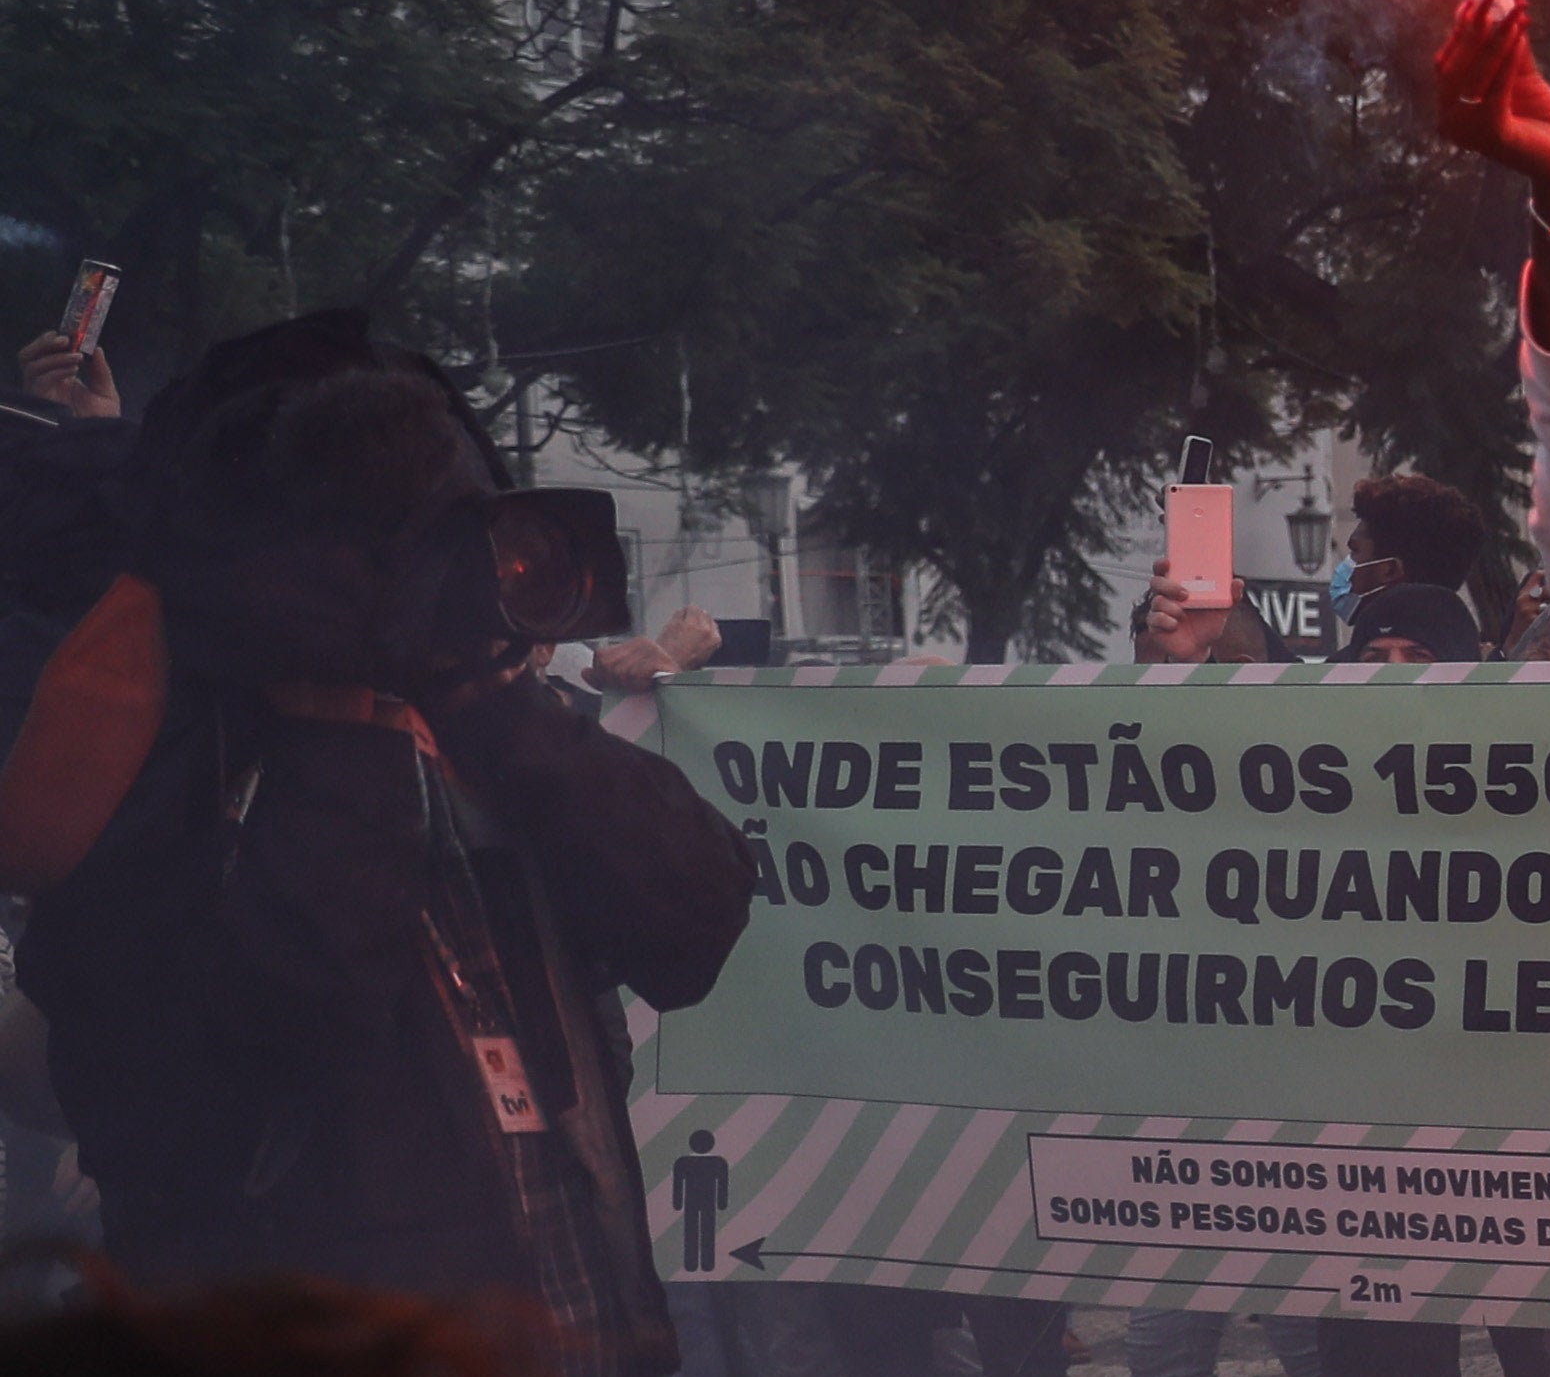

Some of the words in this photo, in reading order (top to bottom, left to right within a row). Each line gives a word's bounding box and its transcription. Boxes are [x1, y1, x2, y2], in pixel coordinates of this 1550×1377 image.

[713, 740, 923, 810] ONDE
[948, 722, 1218, 813] ESTÃO
[1239, 743, 1354, 814] OS
[742, 818, 831, 907] ÃO
[843, 843, 1181, 918] CHEGAR
[803, 941, 1436, 1030] CONSEGUIRMOS
[1131, 1149, 1201, 1186] NÃO
[1210, 1159, 1328, 1191] SOMOS
[1337, 1164, 1387, 1194] UM
[1050, 1196, 1161, 1228] SOMOS
[1169, 1202, 1327, 1236] PESSOAS
[1336, 1208, 1526, 1247] CANSADAS
[1349, 1274, 1402, 1305] 2m
